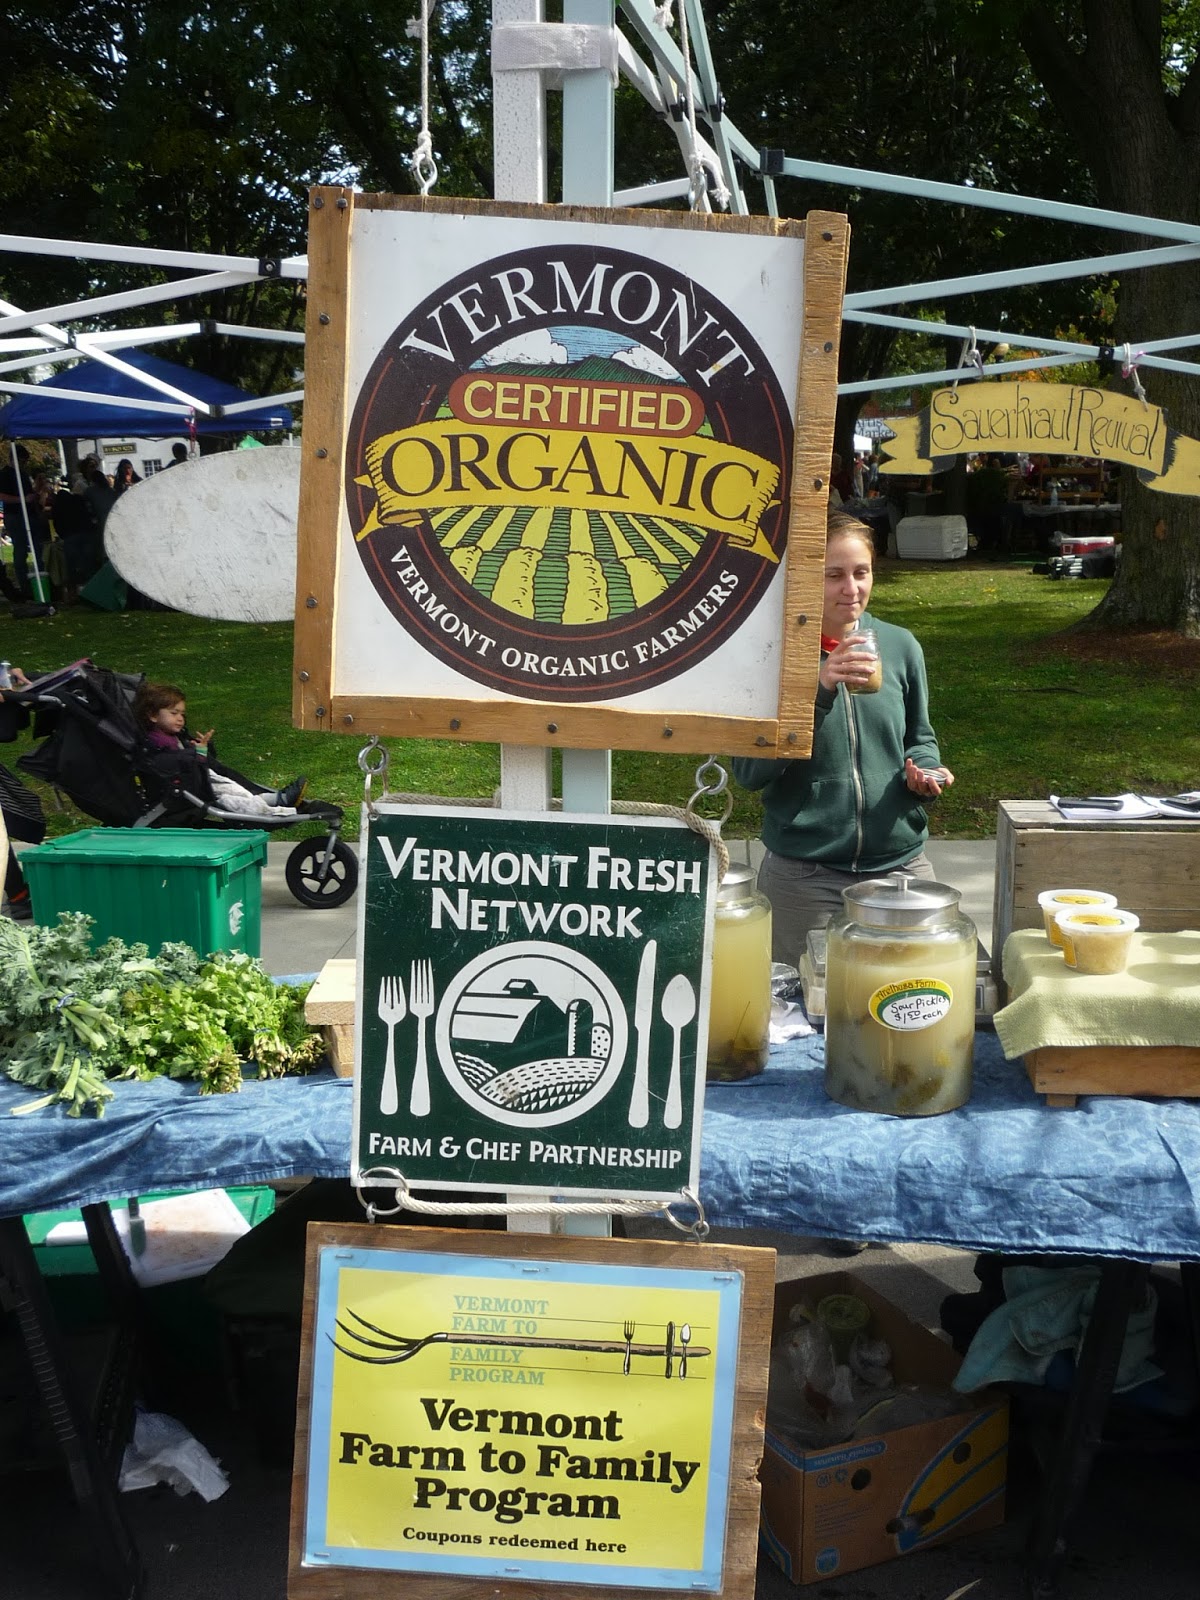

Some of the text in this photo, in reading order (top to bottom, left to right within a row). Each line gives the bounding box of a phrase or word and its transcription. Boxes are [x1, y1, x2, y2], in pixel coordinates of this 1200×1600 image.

[399, 260, 756, 388] VERMONT
[462, 380, 693, 431] CERTIFIED
[931, 384, 1160, 460] Sauerkraut Revival
[382, 432, 758, 523] ORGANIC
[390, 545, 740, 678] VERMONT ORGANIC FARMERS
[377, 835, 702, 894] VERMONT FRESH
[430, 887, 643, 939] NETWORK
[891, 1002, 915, 1014] Sour
[922, 1009, 943, 1020] each
[369, 1132, 682, 1169] FARM & CHEF PARTNERSHIP
[451, 1316, 538, 1336] FARM TO
[453, 1295, 549, 1316] VERMONT
[449, 1346, 524, 1365] FAMILY
[449, 1366, 545, 1386] PROGRAM
[420, 1398, 623, 1442] Vermont
[339, 1432, 701, 1493] Farm to Family
[413, 1477, 621, 1524] Program
[402, 1527, 627, 1554] Coupons redeemed here
